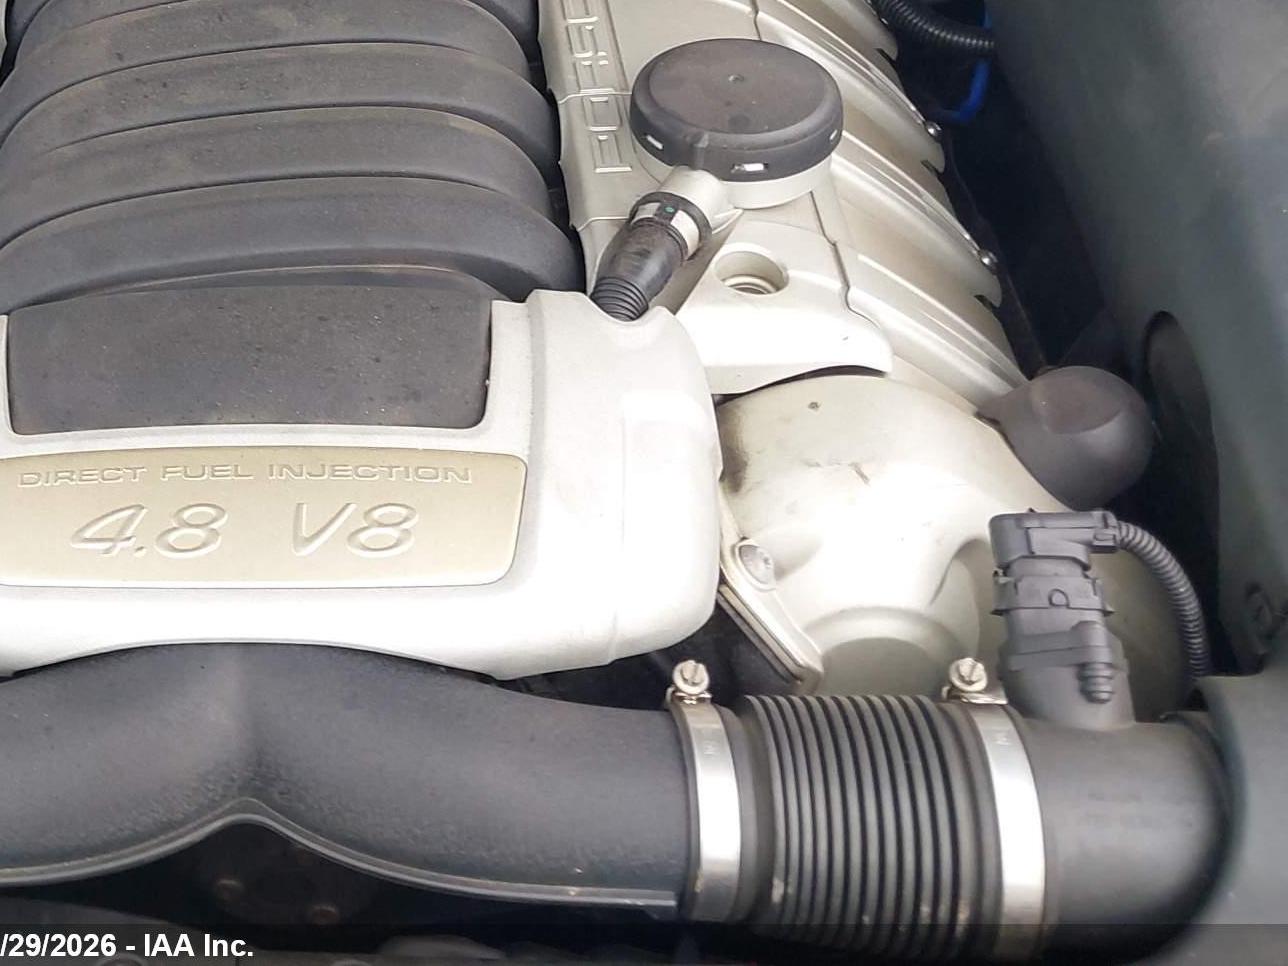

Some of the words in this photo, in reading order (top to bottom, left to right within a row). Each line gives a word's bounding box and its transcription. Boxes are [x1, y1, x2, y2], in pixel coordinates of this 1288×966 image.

[17, 467, 147, 488] DIRECT
[161, 464, 254, 482] FUEL
[268, 463, 473, 484] INJECTION
[70, 503, 228, 559] 4.8
[292, 502, 420, 558] V8
